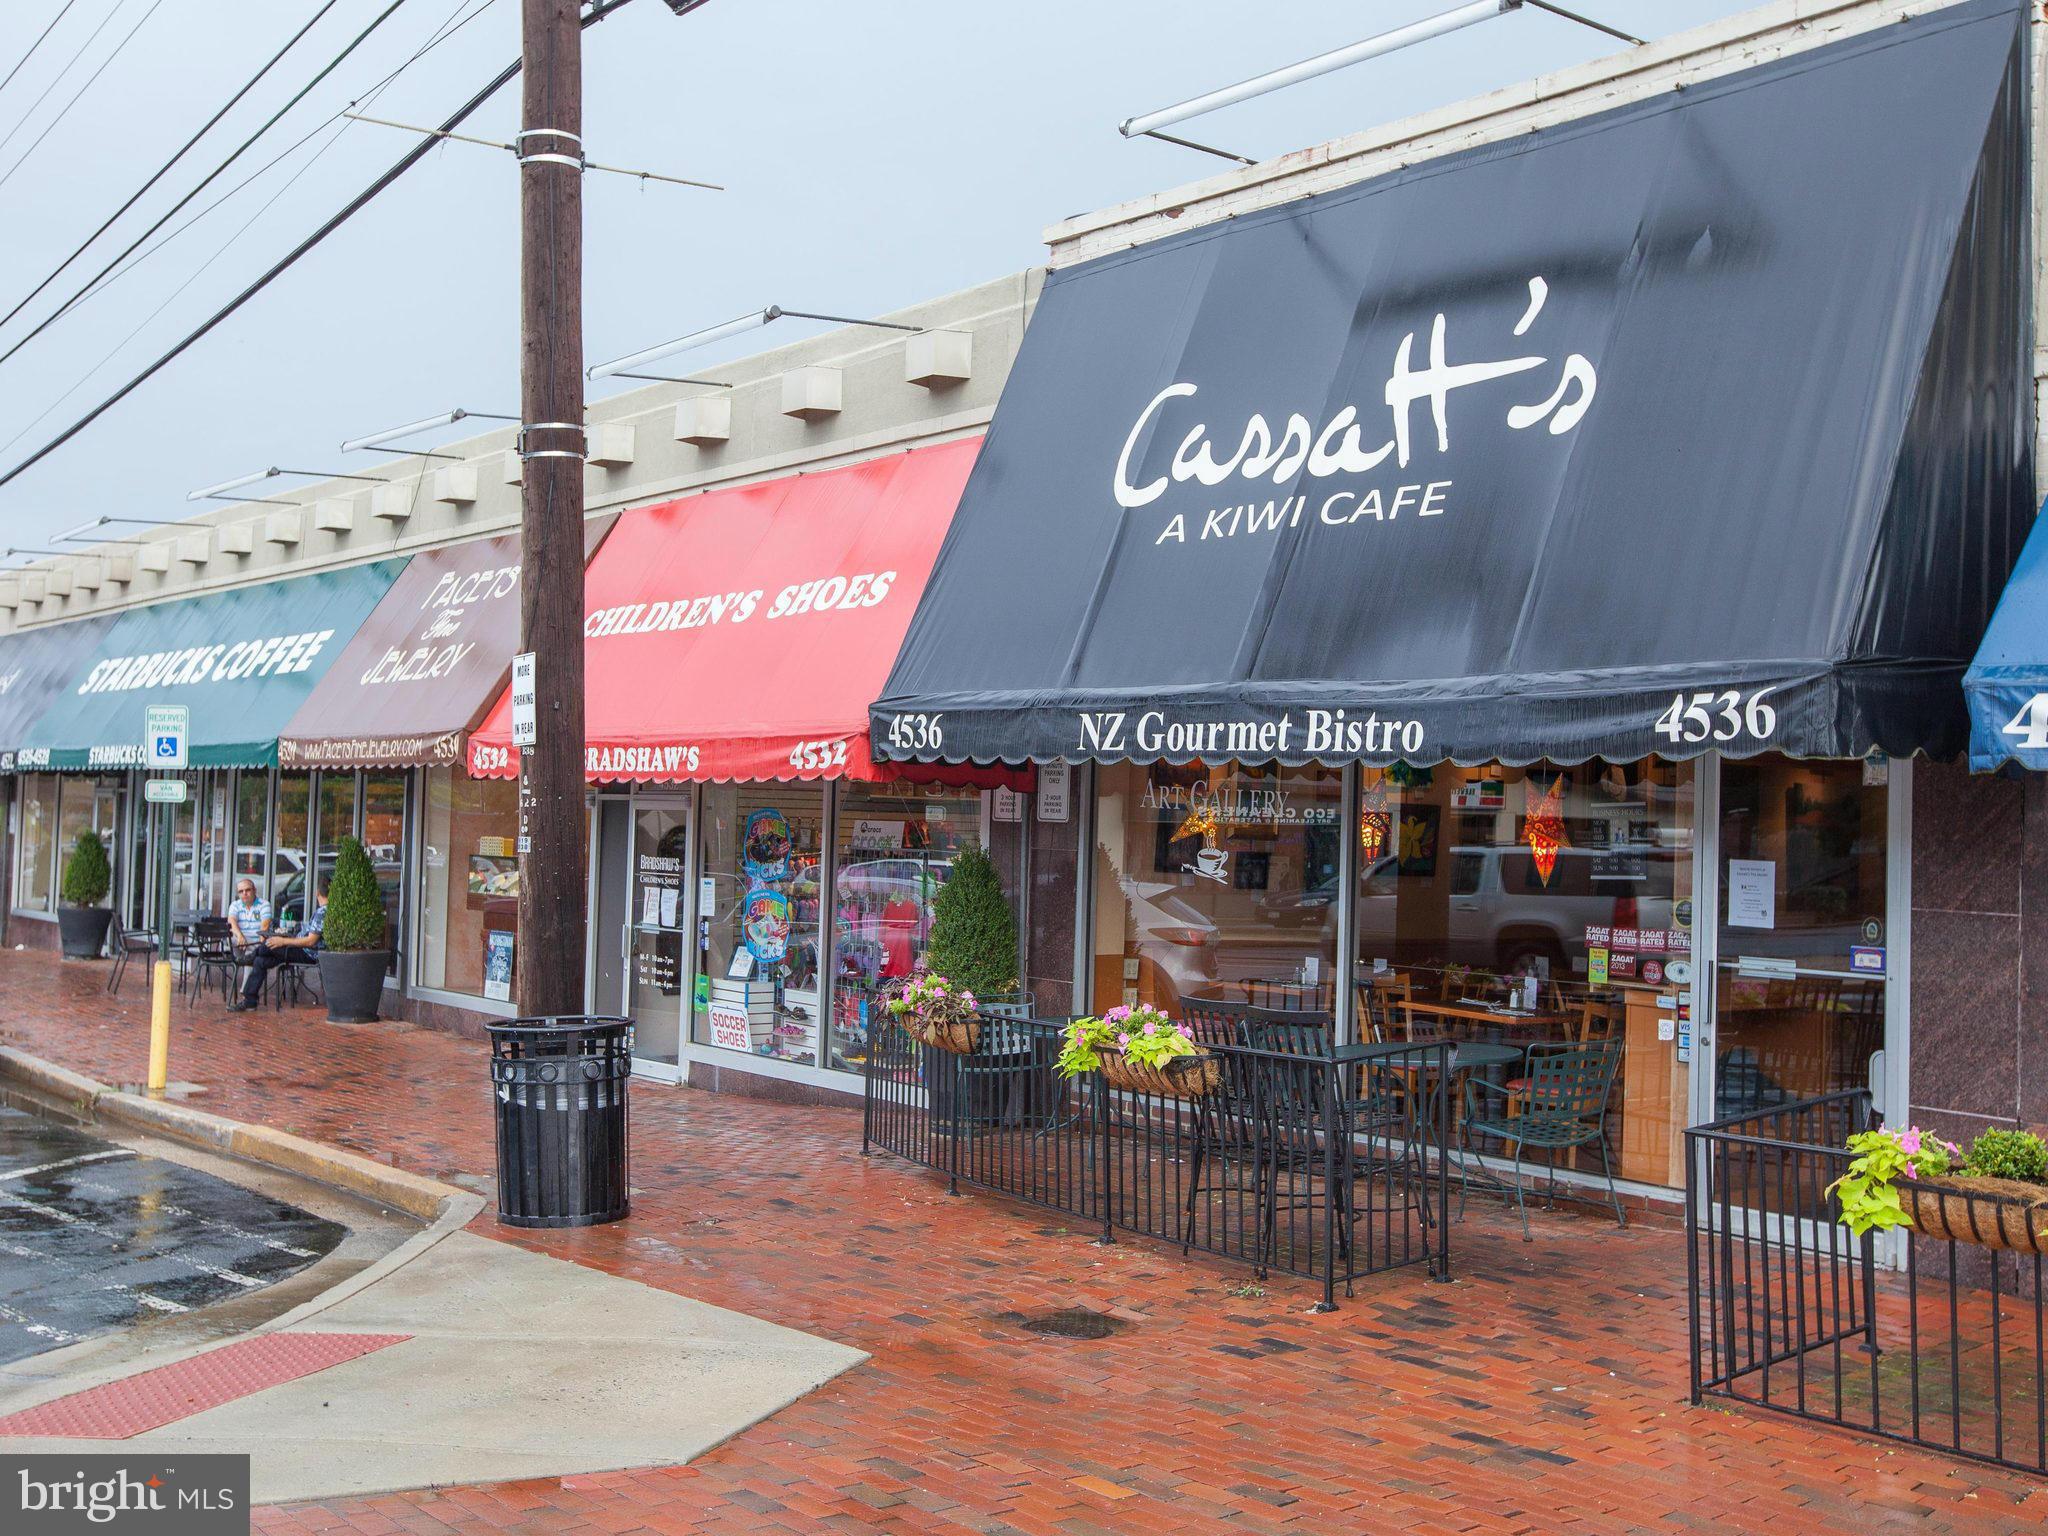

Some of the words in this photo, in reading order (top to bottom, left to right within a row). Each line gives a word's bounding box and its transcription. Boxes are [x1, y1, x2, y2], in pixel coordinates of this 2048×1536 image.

[1155, 513, 1186, 545] A
[1200, 495, 1307, 541] KIWI
[1319, 480, 1453, 526] CAFE
[421, 565, 522, 610] FACETS
[584, 589, 764, 638] CHILDREN'S
[766, 570, 897, 619] SHOES
[78, 643, 226, 695] STARBUCKS
[211, 628, 336, 683] COFFEE
[360, 642, 476, 686] JEWELRY
[517, 663, 530, 678] MORE
[513, 693, 534, 706] PARKING
[149, 713, 185, 723] RESERVED
[1654, 686, 1777, 744] 4536
[151, 724, 183, 733] PARKING
[515, 723, 520, 735] IN
[521, 721, 534, 734] REAR
[888, 712, 944, 750] 4536
[1077, 713, 1126, 752] NZ
[1136, 711, 1292, 752] Gourmet
[1303, 708, 1425, 753] Bistro
[88, 745, 137, 766] STARBUCKS
[473, 746, 509, 770] 4532
[584, 746, 700, 772] RADSHAW'S
[788, 740, 848, 770] 4532
[160, 784, 173, 792] VAN
[1140, 778, 1186, 811] ART
[1190, 779, 1291, 815] GALLERY
[749, 818, 786, 838] GAME
[640, 854, 680, 872] BRADSHAW'S
[748, 899, 785, 919] GAME
[1586, 926, 1610, 935] ZAGAT
[1586, 933, 1610, 942] RATED
[1613, 929, 1637, 937] ZAGAT
[1640, 930, 1665, 939] ZAGAT
[1613, 937, 1637, 945] RATED
[1640, 938, 1665, 946] RATED
[1610, 962, 1626, 970] 2013
[1611, 954, 1635, 964] ZAGAT
[712, 1012, 747, 1032] SOCCER
[716, 1029, 747, 1049] SHOES
